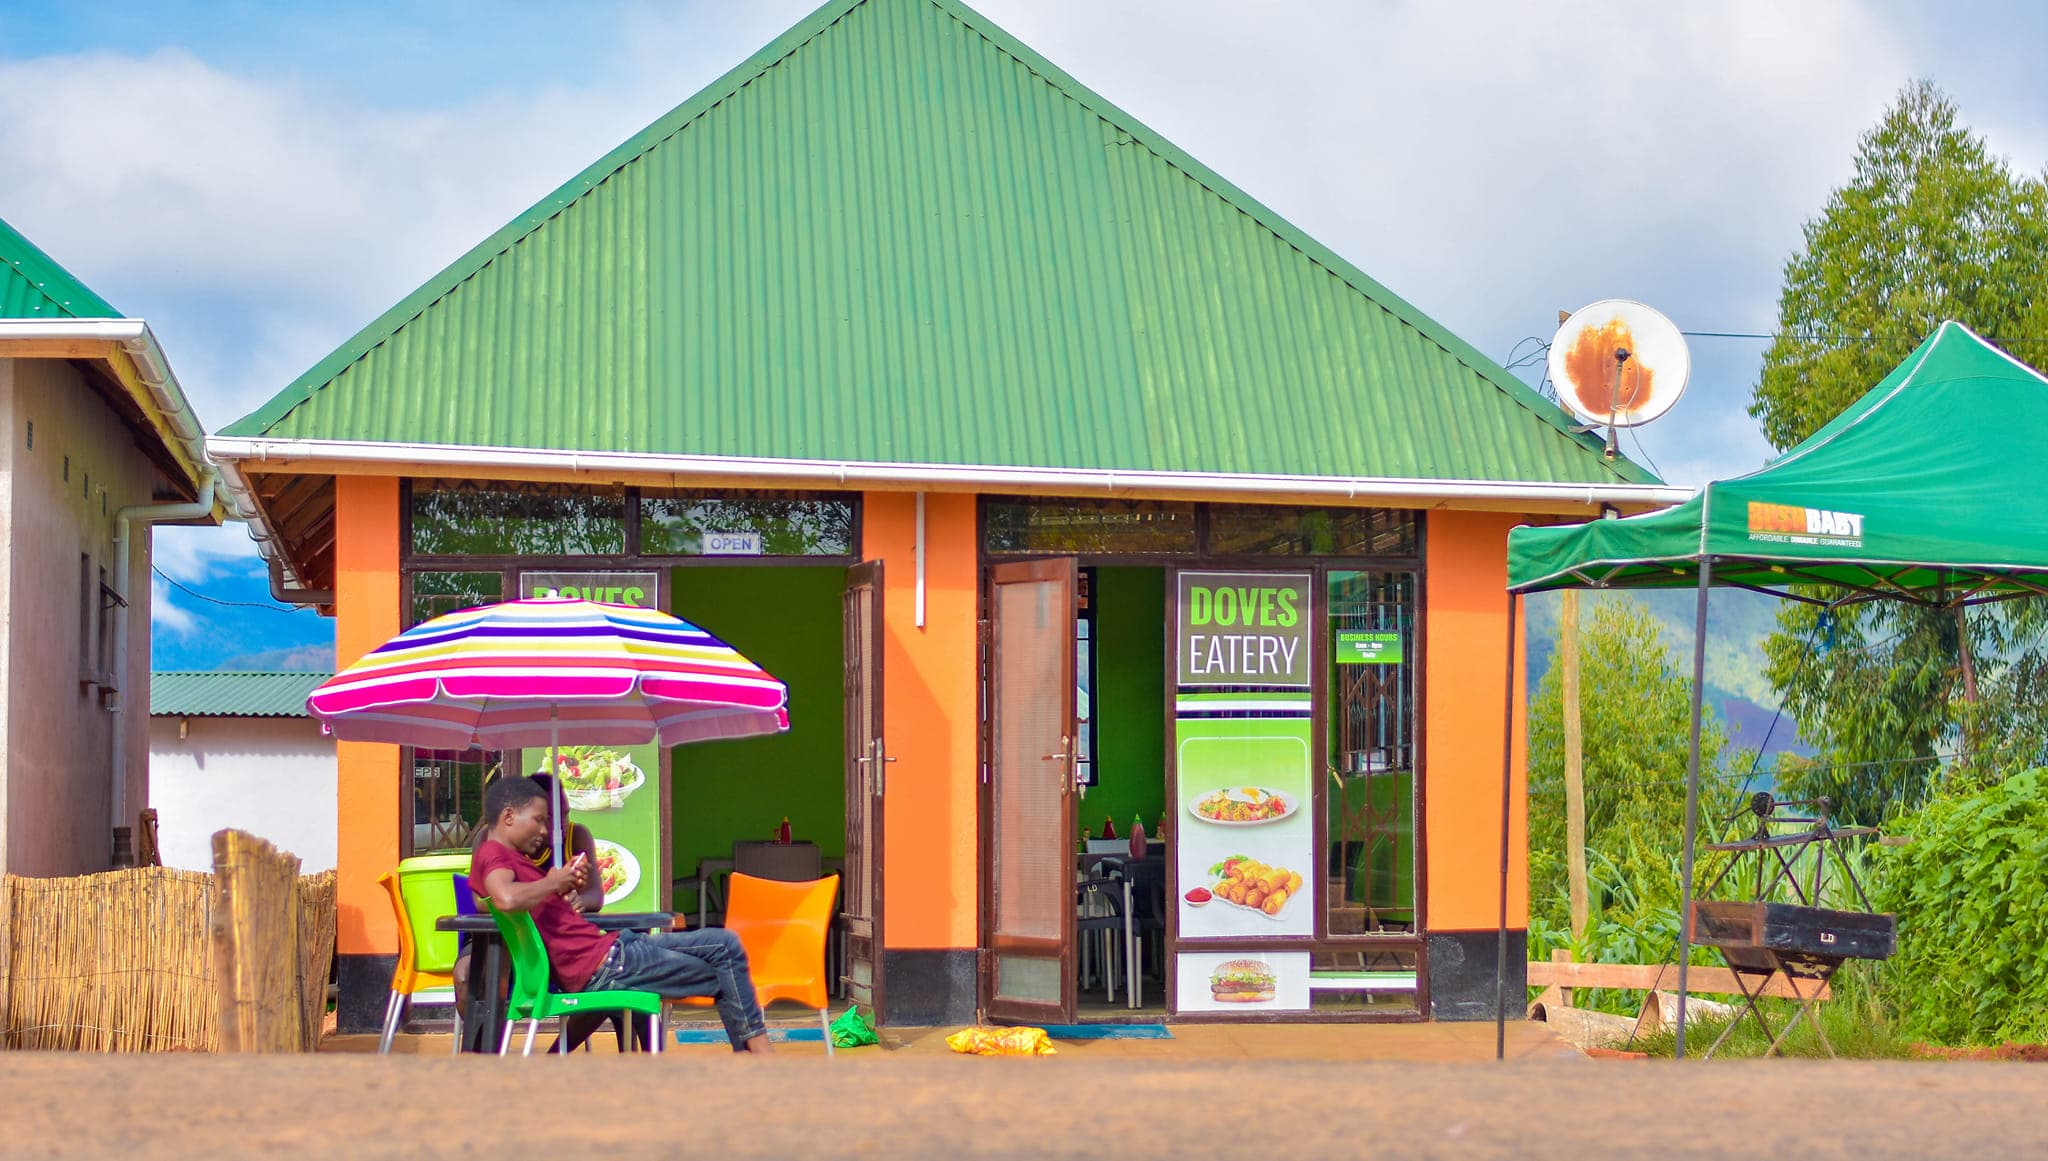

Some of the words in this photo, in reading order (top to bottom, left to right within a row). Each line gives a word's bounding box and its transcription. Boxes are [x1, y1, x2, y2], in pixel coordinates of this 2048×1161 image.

[711, 538, 752, 550] OPEN
[1191, 587, 1298, 627] DOVES
[1340, 633, 1374, 642] BUSINESS
[1375, 633, 1398, 642] HOURS
[1190, 635, 1299, 675] EATERY
